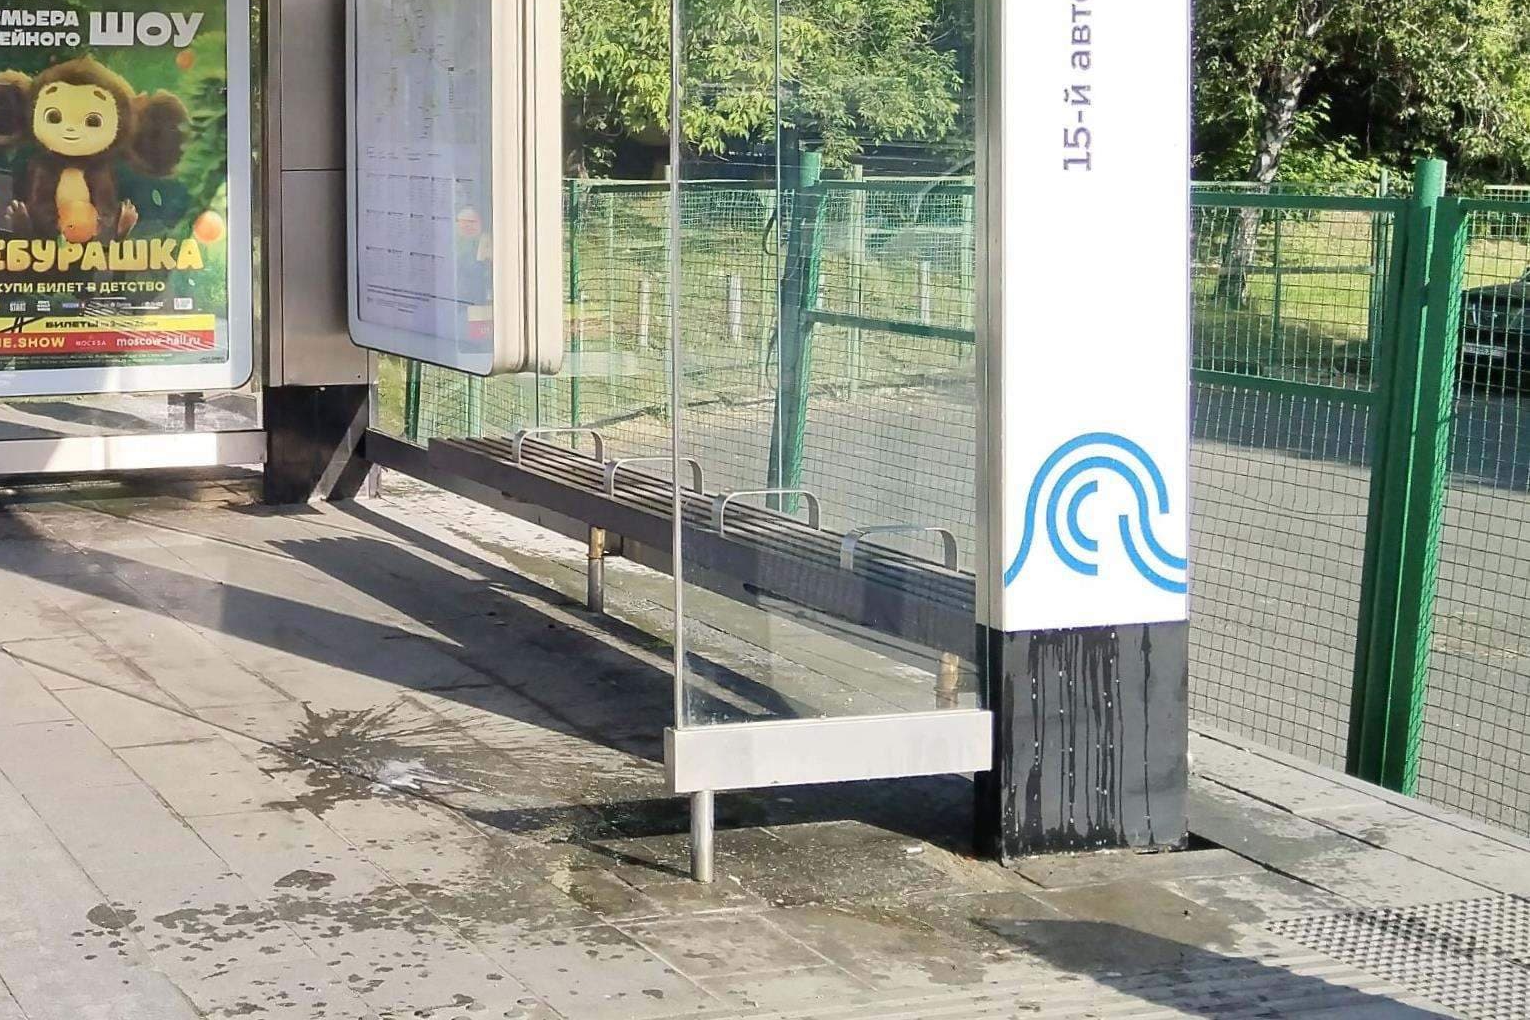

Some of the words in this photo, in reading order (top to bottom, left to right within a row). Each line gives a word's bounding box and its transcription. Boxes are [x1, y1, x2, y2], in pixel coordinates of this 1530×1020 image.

[89, 11, 205, 48] ШОУ
[1063, 83, 1092, 172] 15-й
[36, 282, 84, 294] БИЛЕТ
[86, 282, 96, 293] В
[99, 281, 166, 294] ДЕТСТВО
[45, 320, 99, 329] БИЛЕТЫ
[116, 336, 201, 348] moscow-hall.ru
